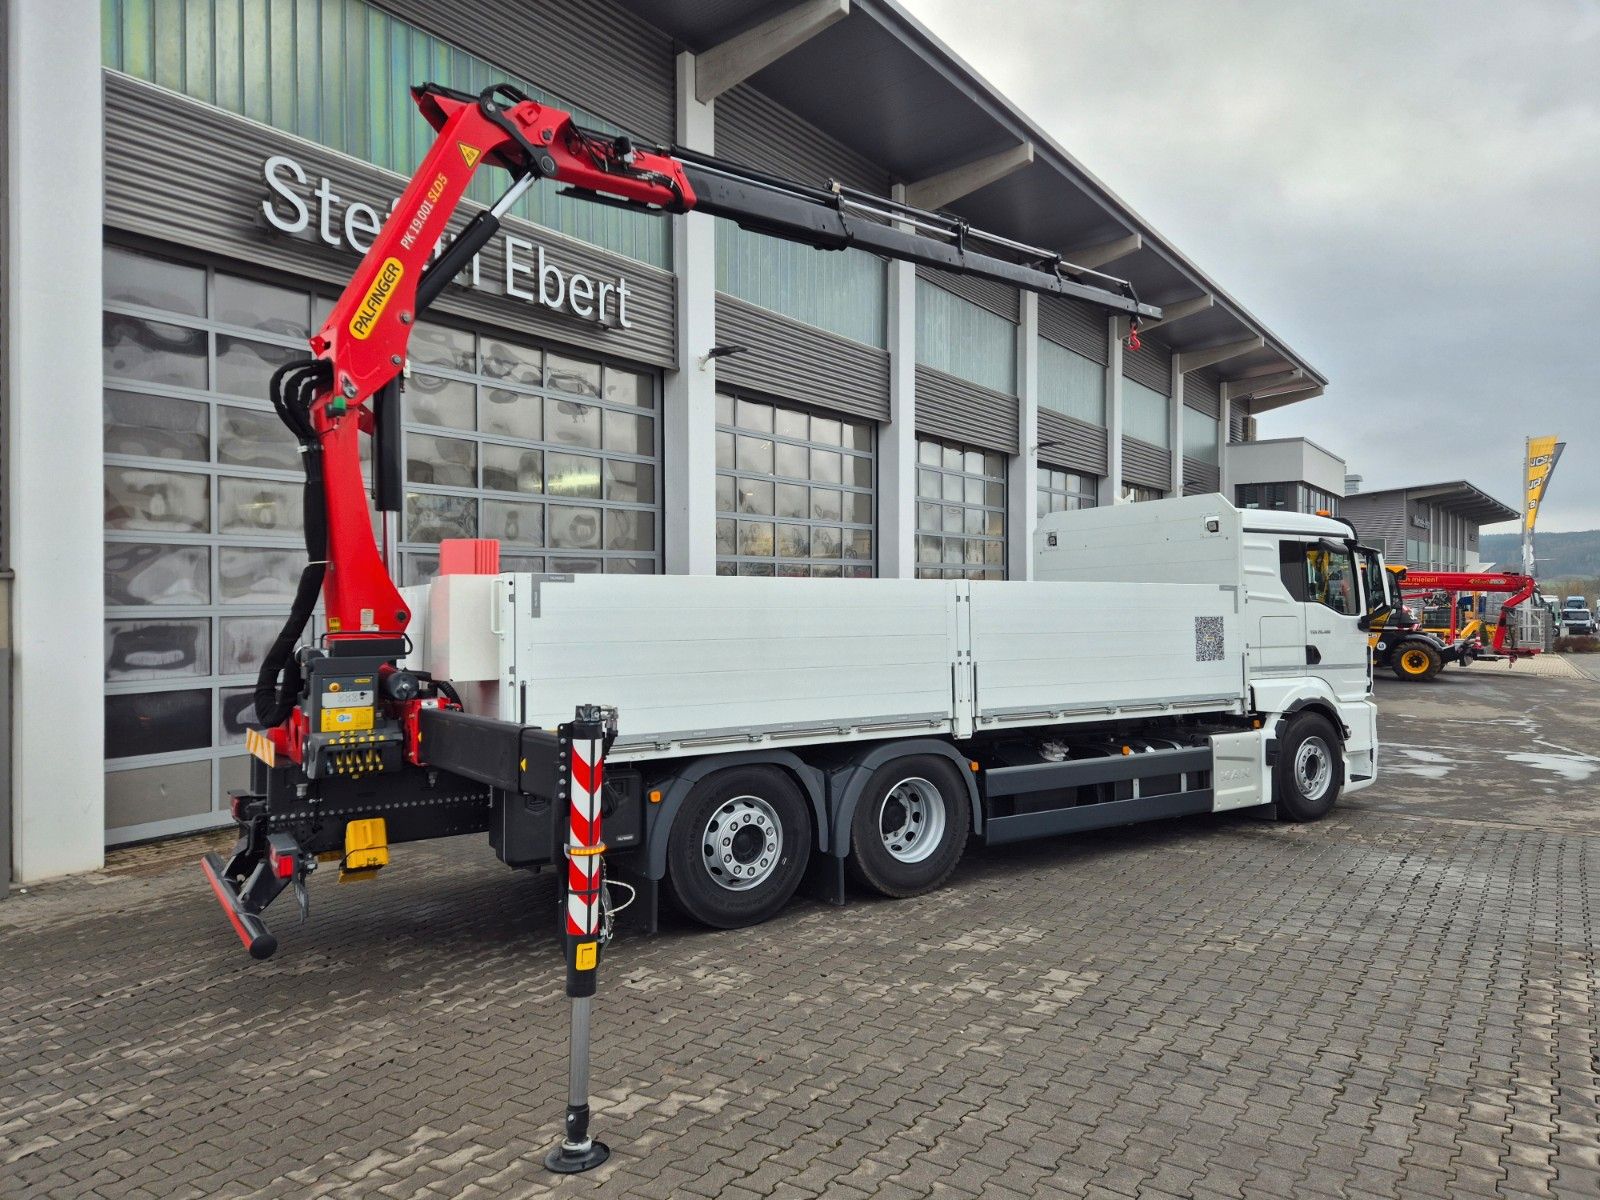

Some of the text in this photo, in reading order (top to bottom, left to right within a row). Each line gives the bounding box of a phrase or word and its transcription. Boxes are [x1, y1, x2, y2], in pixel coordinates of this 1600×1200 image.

[400, 172, 448, 250] PK 19.001 SLD5
[353, 263, 400, 335] PALFINGER
[505, 235, 632, 328] Ebert
